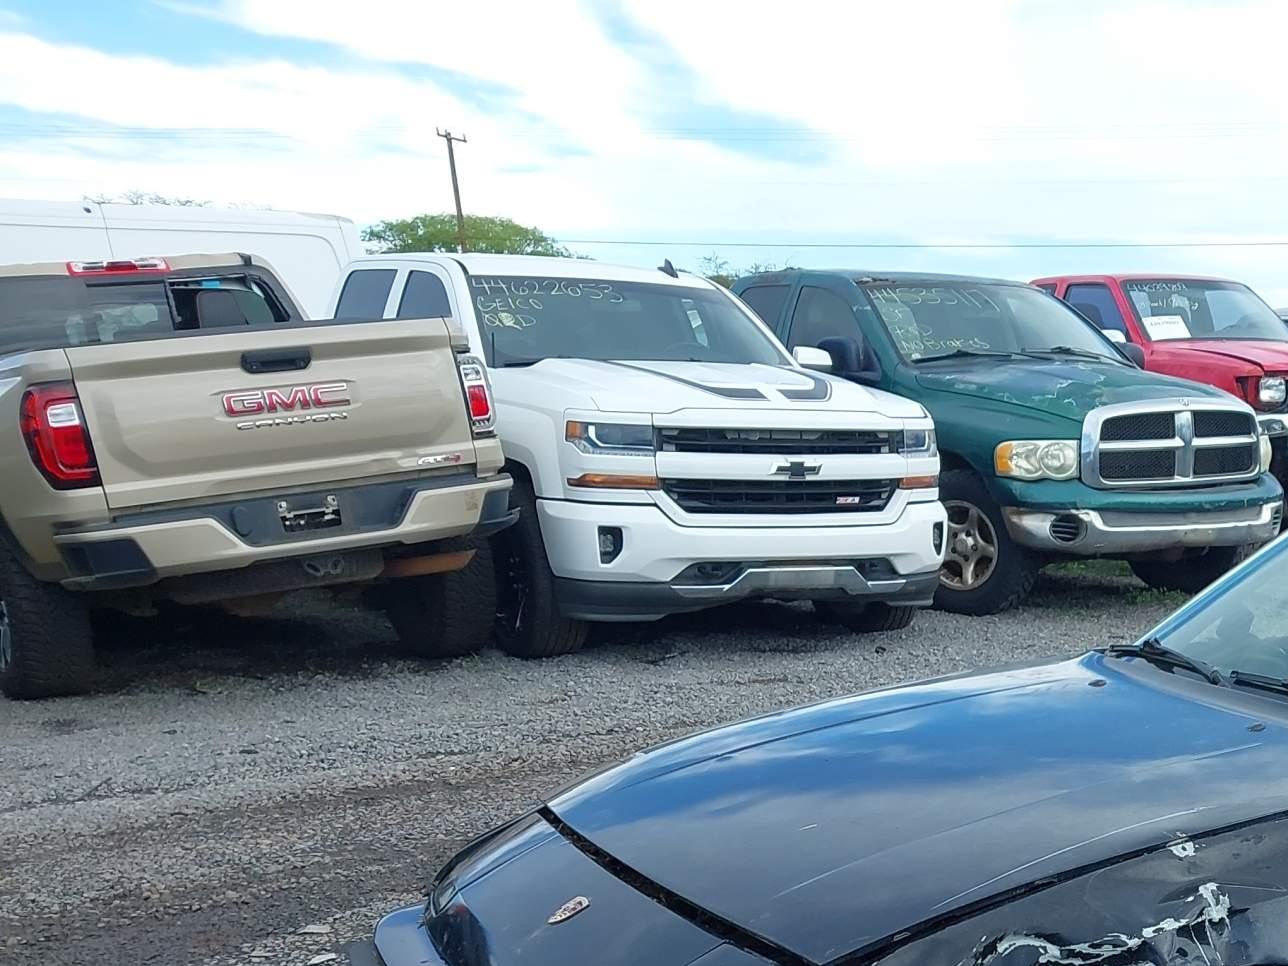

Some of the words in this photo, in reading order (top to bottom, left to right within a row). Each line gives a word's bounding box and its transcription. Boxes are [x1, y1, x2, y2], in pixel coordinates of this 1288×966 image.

[471, 278, 624, 303] 44622653
[476, 295, 543, 312] GEICO
[223, 383, 351, 417] GMC
[236, 412, 349, 431] CANYON
